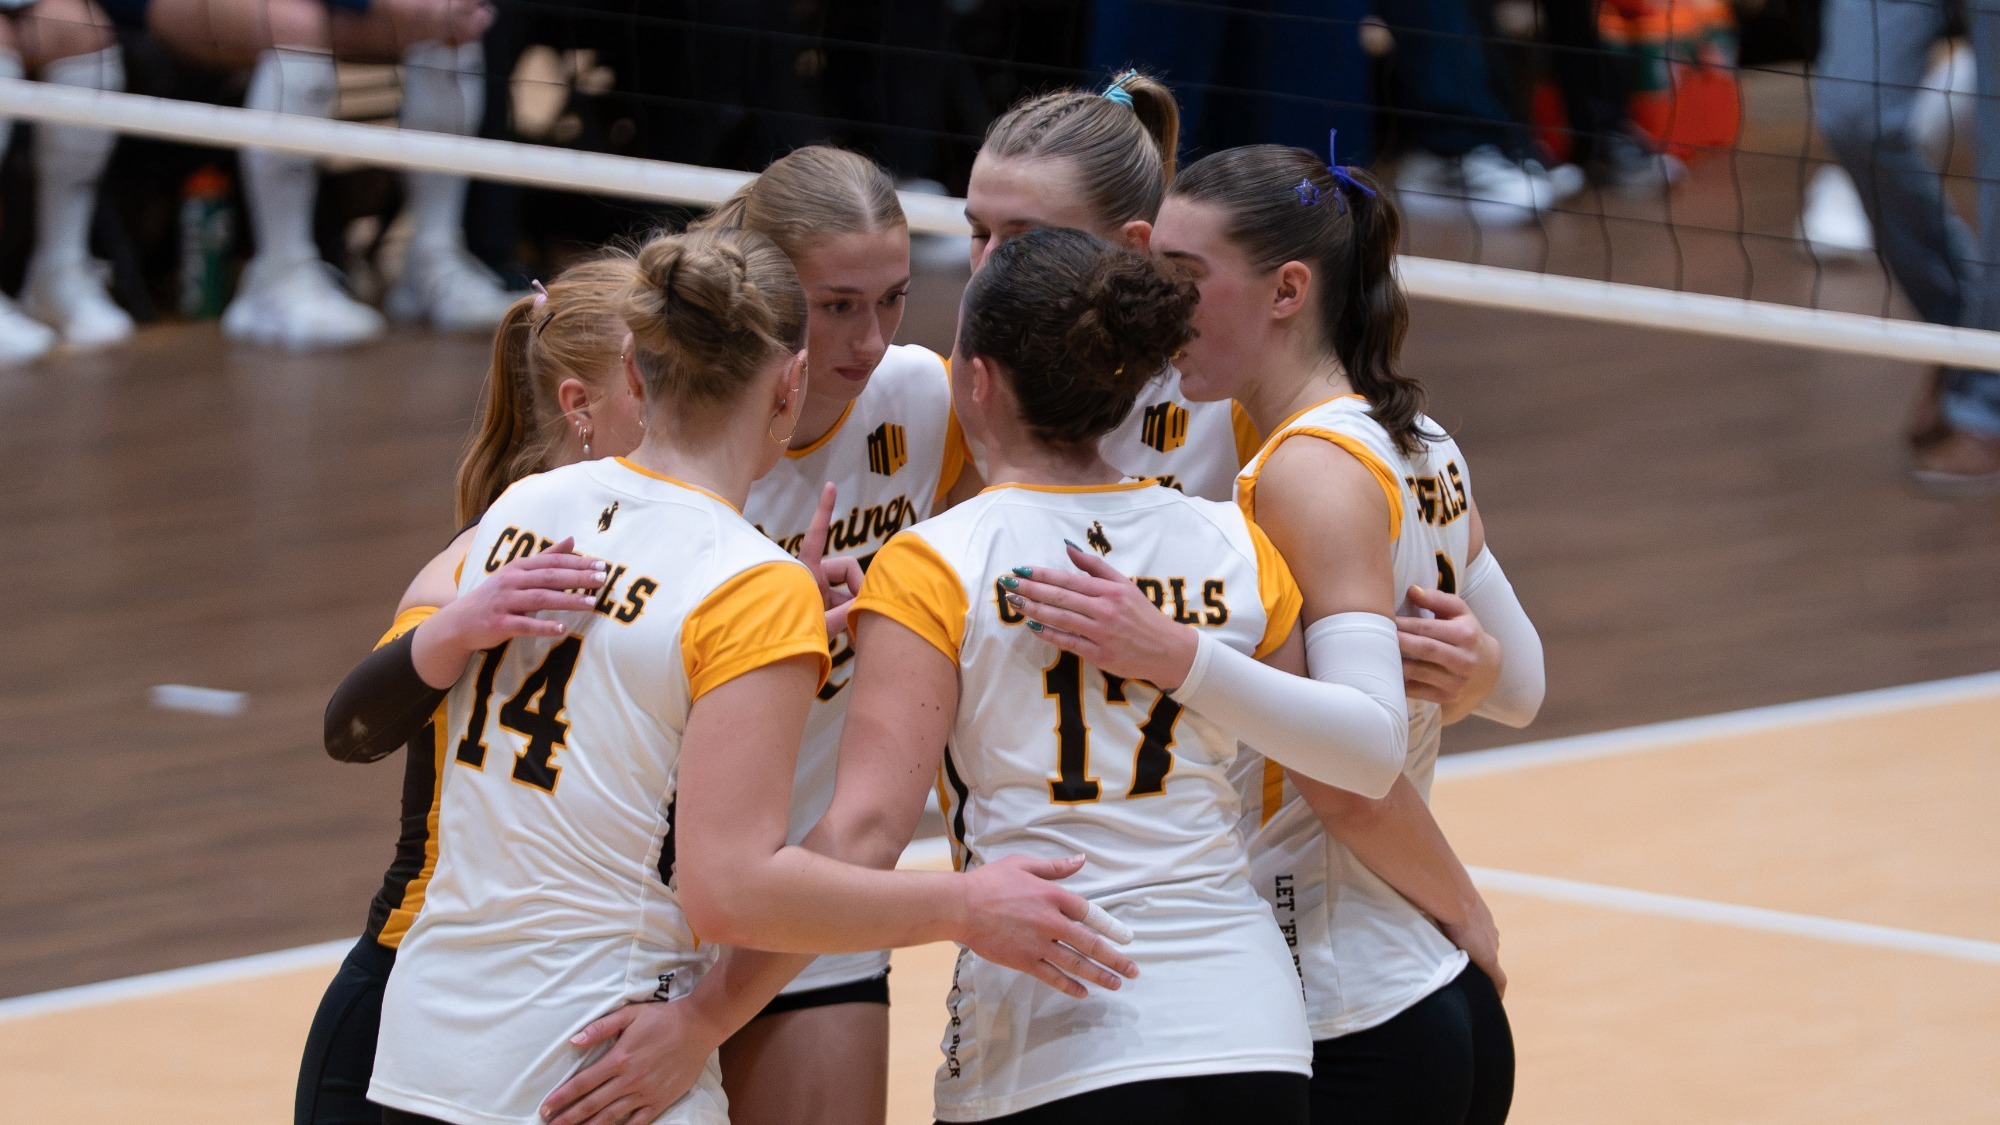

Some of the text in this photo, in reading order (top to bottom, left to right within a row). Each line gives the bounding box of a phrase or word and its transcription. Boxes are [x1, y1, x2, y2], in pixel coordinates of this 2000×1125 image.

[455, 632, 584, 796] 14
[1042, 649, 1185, 806] 17
[1275, 874, 1295, 911] LET
